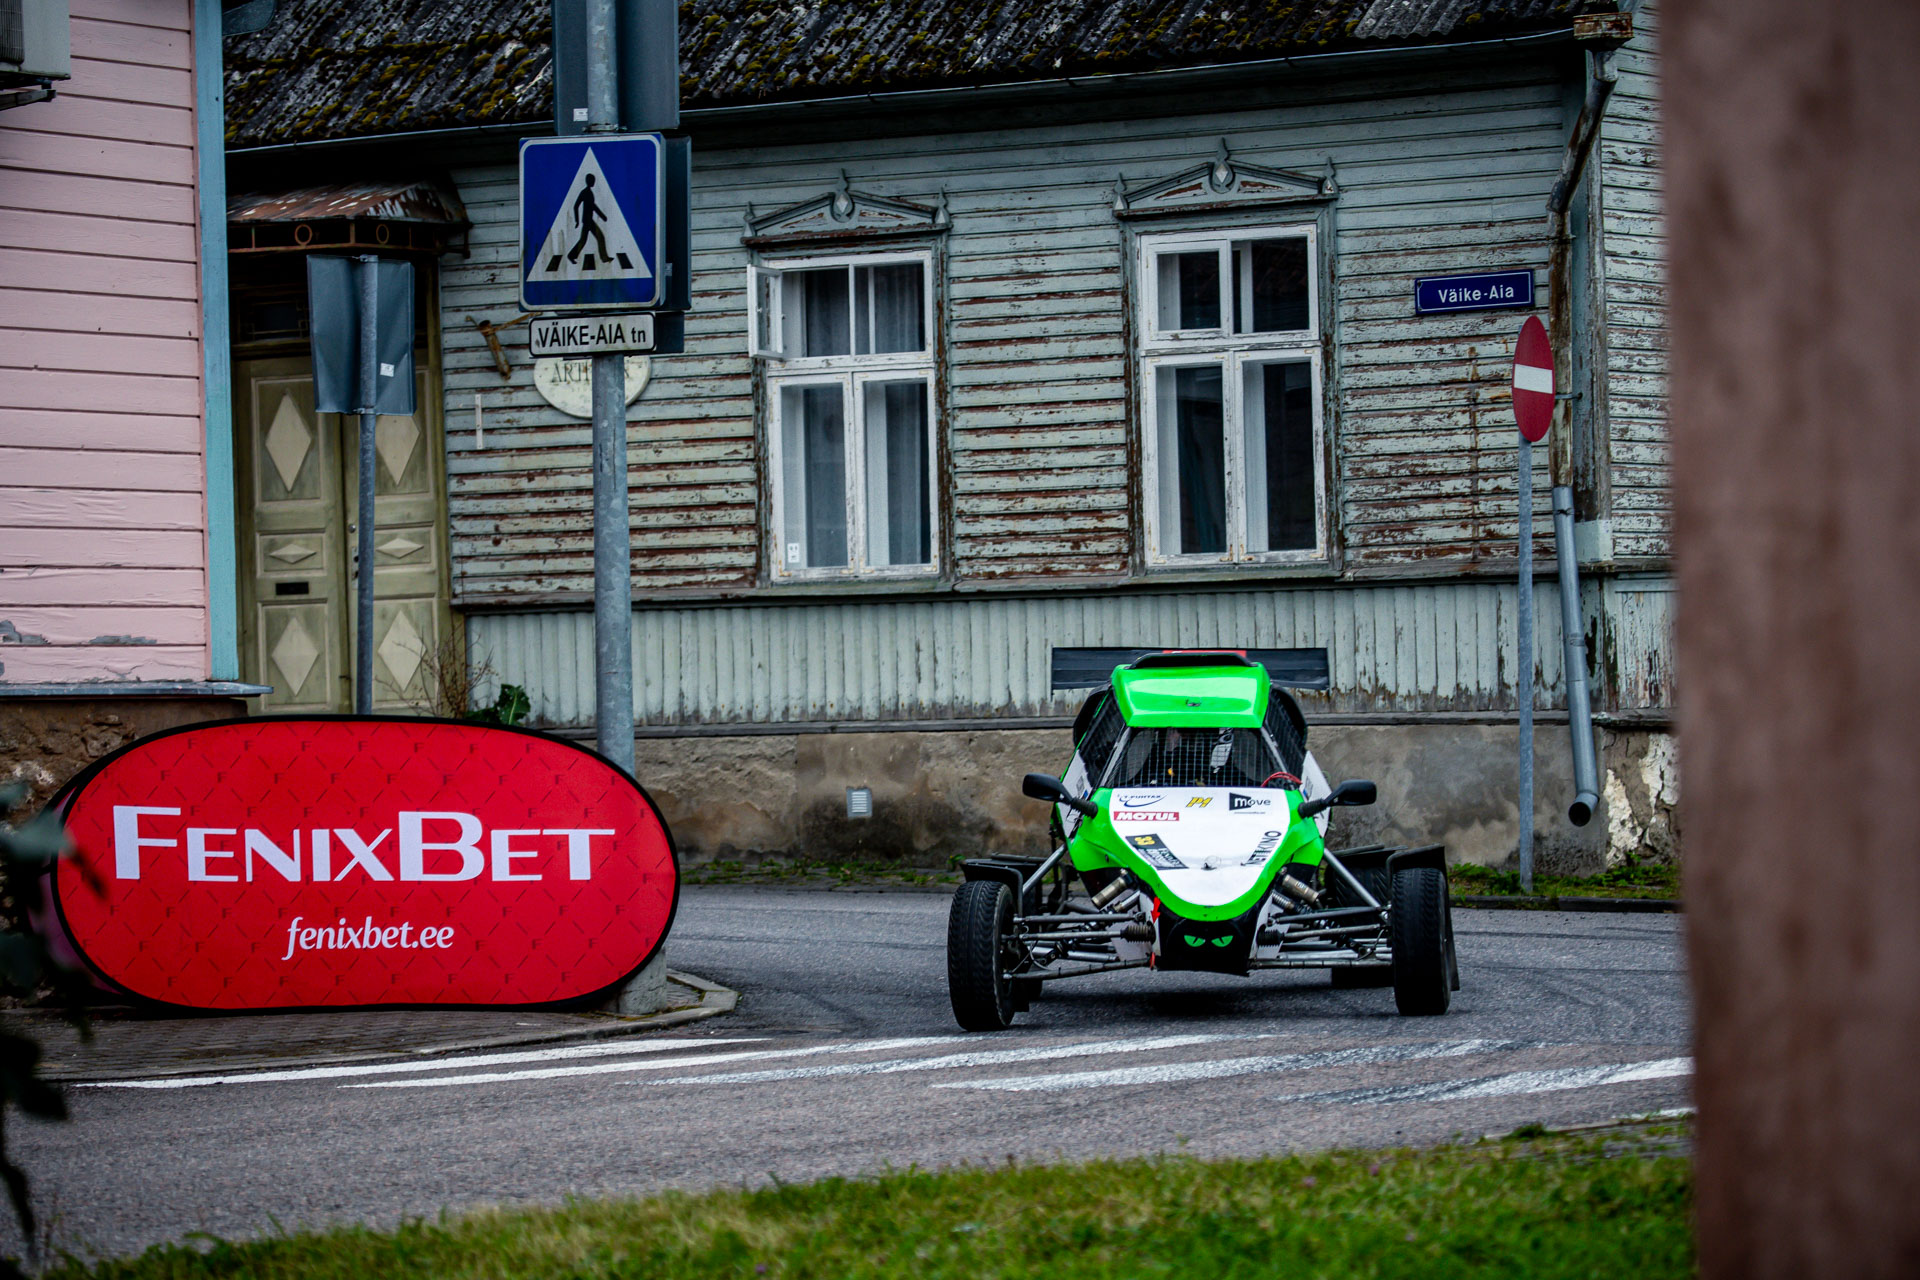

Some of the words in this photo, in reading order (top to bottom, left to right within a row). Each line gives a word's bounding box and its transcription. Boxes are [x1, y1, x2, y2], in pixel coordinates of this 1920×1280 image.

[1438, 284, 1514, 303] Väike-Aia
[538, 321, 625, 348] VÄIKE-AIA
[630, 326, 646, 344] tn
[1234, 797, 1271, 808] move
[1116, 811, 1177, 821] MOTUL
[281, 916, 454, 961] fenixbet.ee
